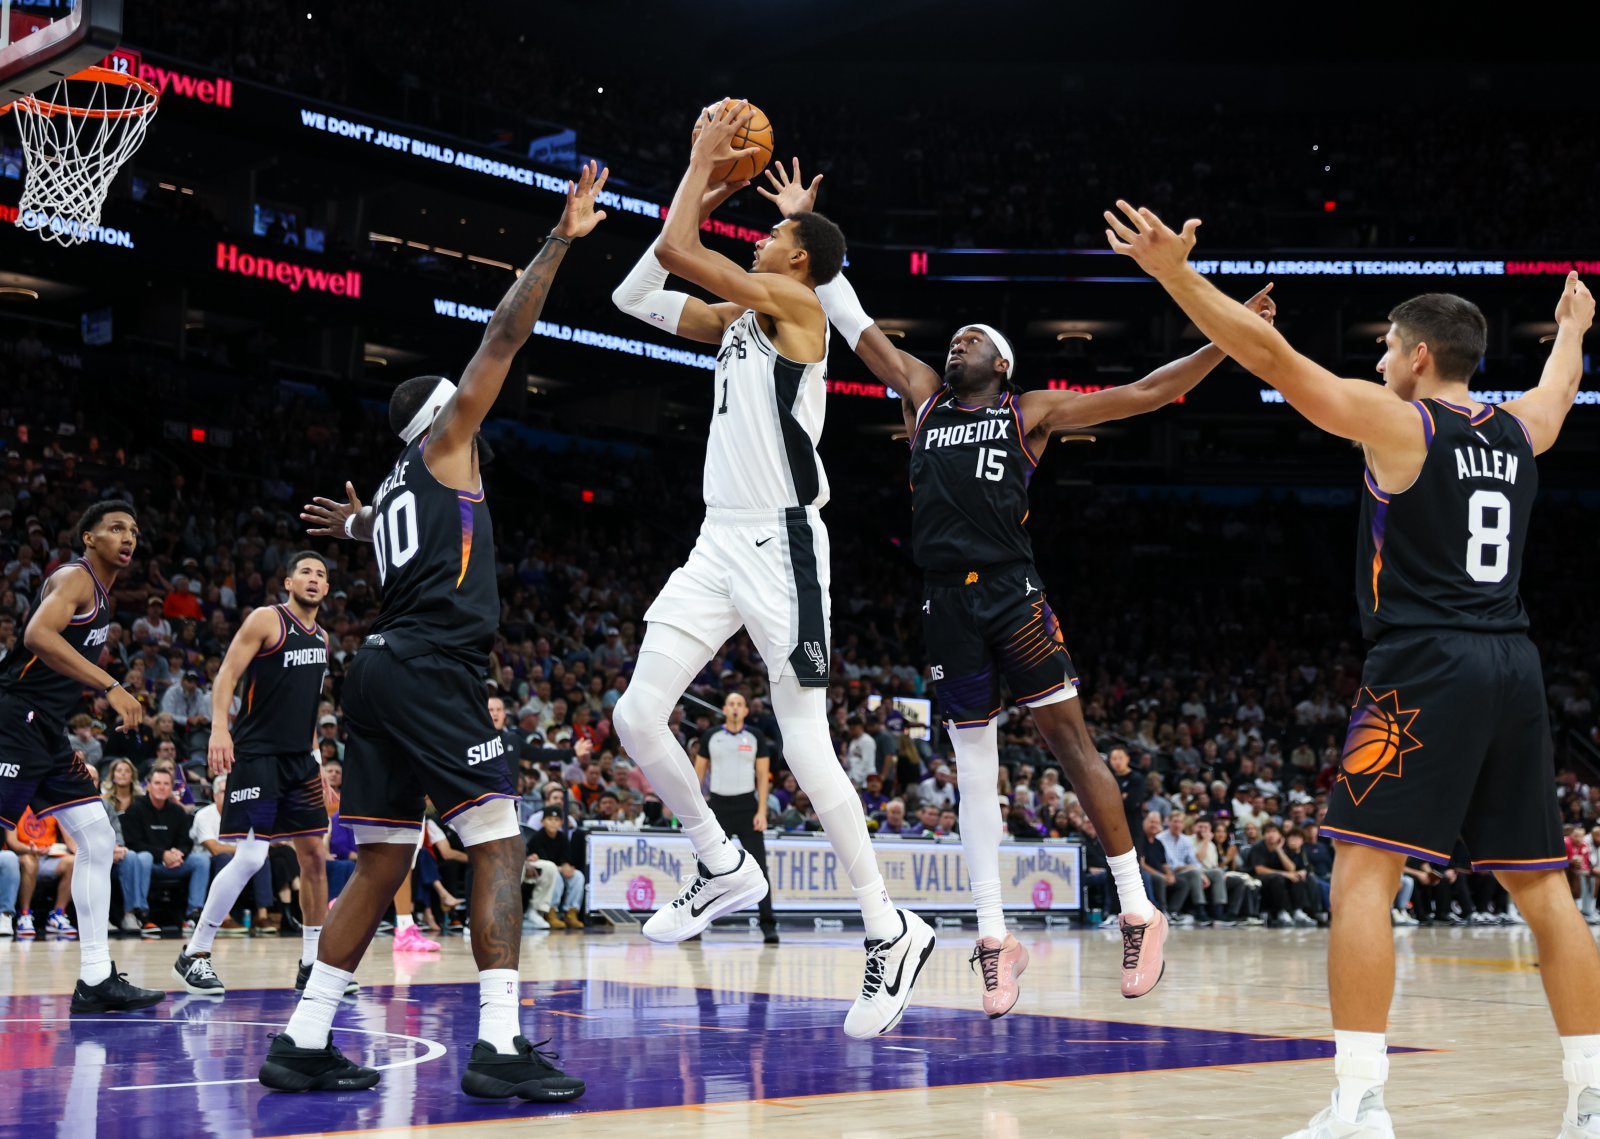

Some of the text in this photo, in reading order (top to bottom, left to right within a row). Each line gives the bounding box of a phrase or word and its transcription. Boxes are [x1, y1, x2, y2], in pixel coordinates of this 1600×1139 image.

[112, 56, 129, 75] 12
[139, 62, 232, 107] eywell
[301, 108, 326, 131] WE
[328, 116, 374, 142] DON'T
[374, 130, 411, 152] JUST
[411, 139, 455, 164] BUILD
[455, 151, 534, 186] AEROSPACE
[534, 172, 621, 211] TECHOGY,
[621, 195, 660, 219] WE'RE
[713, 219, 736, 239] THE
[216, 241, 361, 299] Honeywell
[1220, 260, 1266, 275] BUILD
[1266, 260, 1352, 275] AEROSPACE
[1353, 260, 1456, 277] TECHNOLOGY,
[1457, 260, 1504, 275] WE'RE
[1505, 260, 1573, 275] SHAPING
[434, 298, 457, 317] WE
[532, 319, 572, 341] BUILD
[572, 327, 644, 356] AEROSPACE
[644, 342, 717, 371] TECHNOLOG
[834, 380, 885, 399] FUTURE
[986, 407, 1010, 417] PayPal
[925, 419, 1011, 450] PHOENIX
[975, 447, 1008, 482] 15
[1454, 446, 1518, 485] ALLEN
[373, 489, 419, 587] 00
[1465, 489, 1511, 583] 8
[283, 647, 328, 668] PHOENIX
[600, 838, 682, 885] JIM BEAM
[884, 861, 906, 881] THE
[912, 853, 972, 892] VALL
